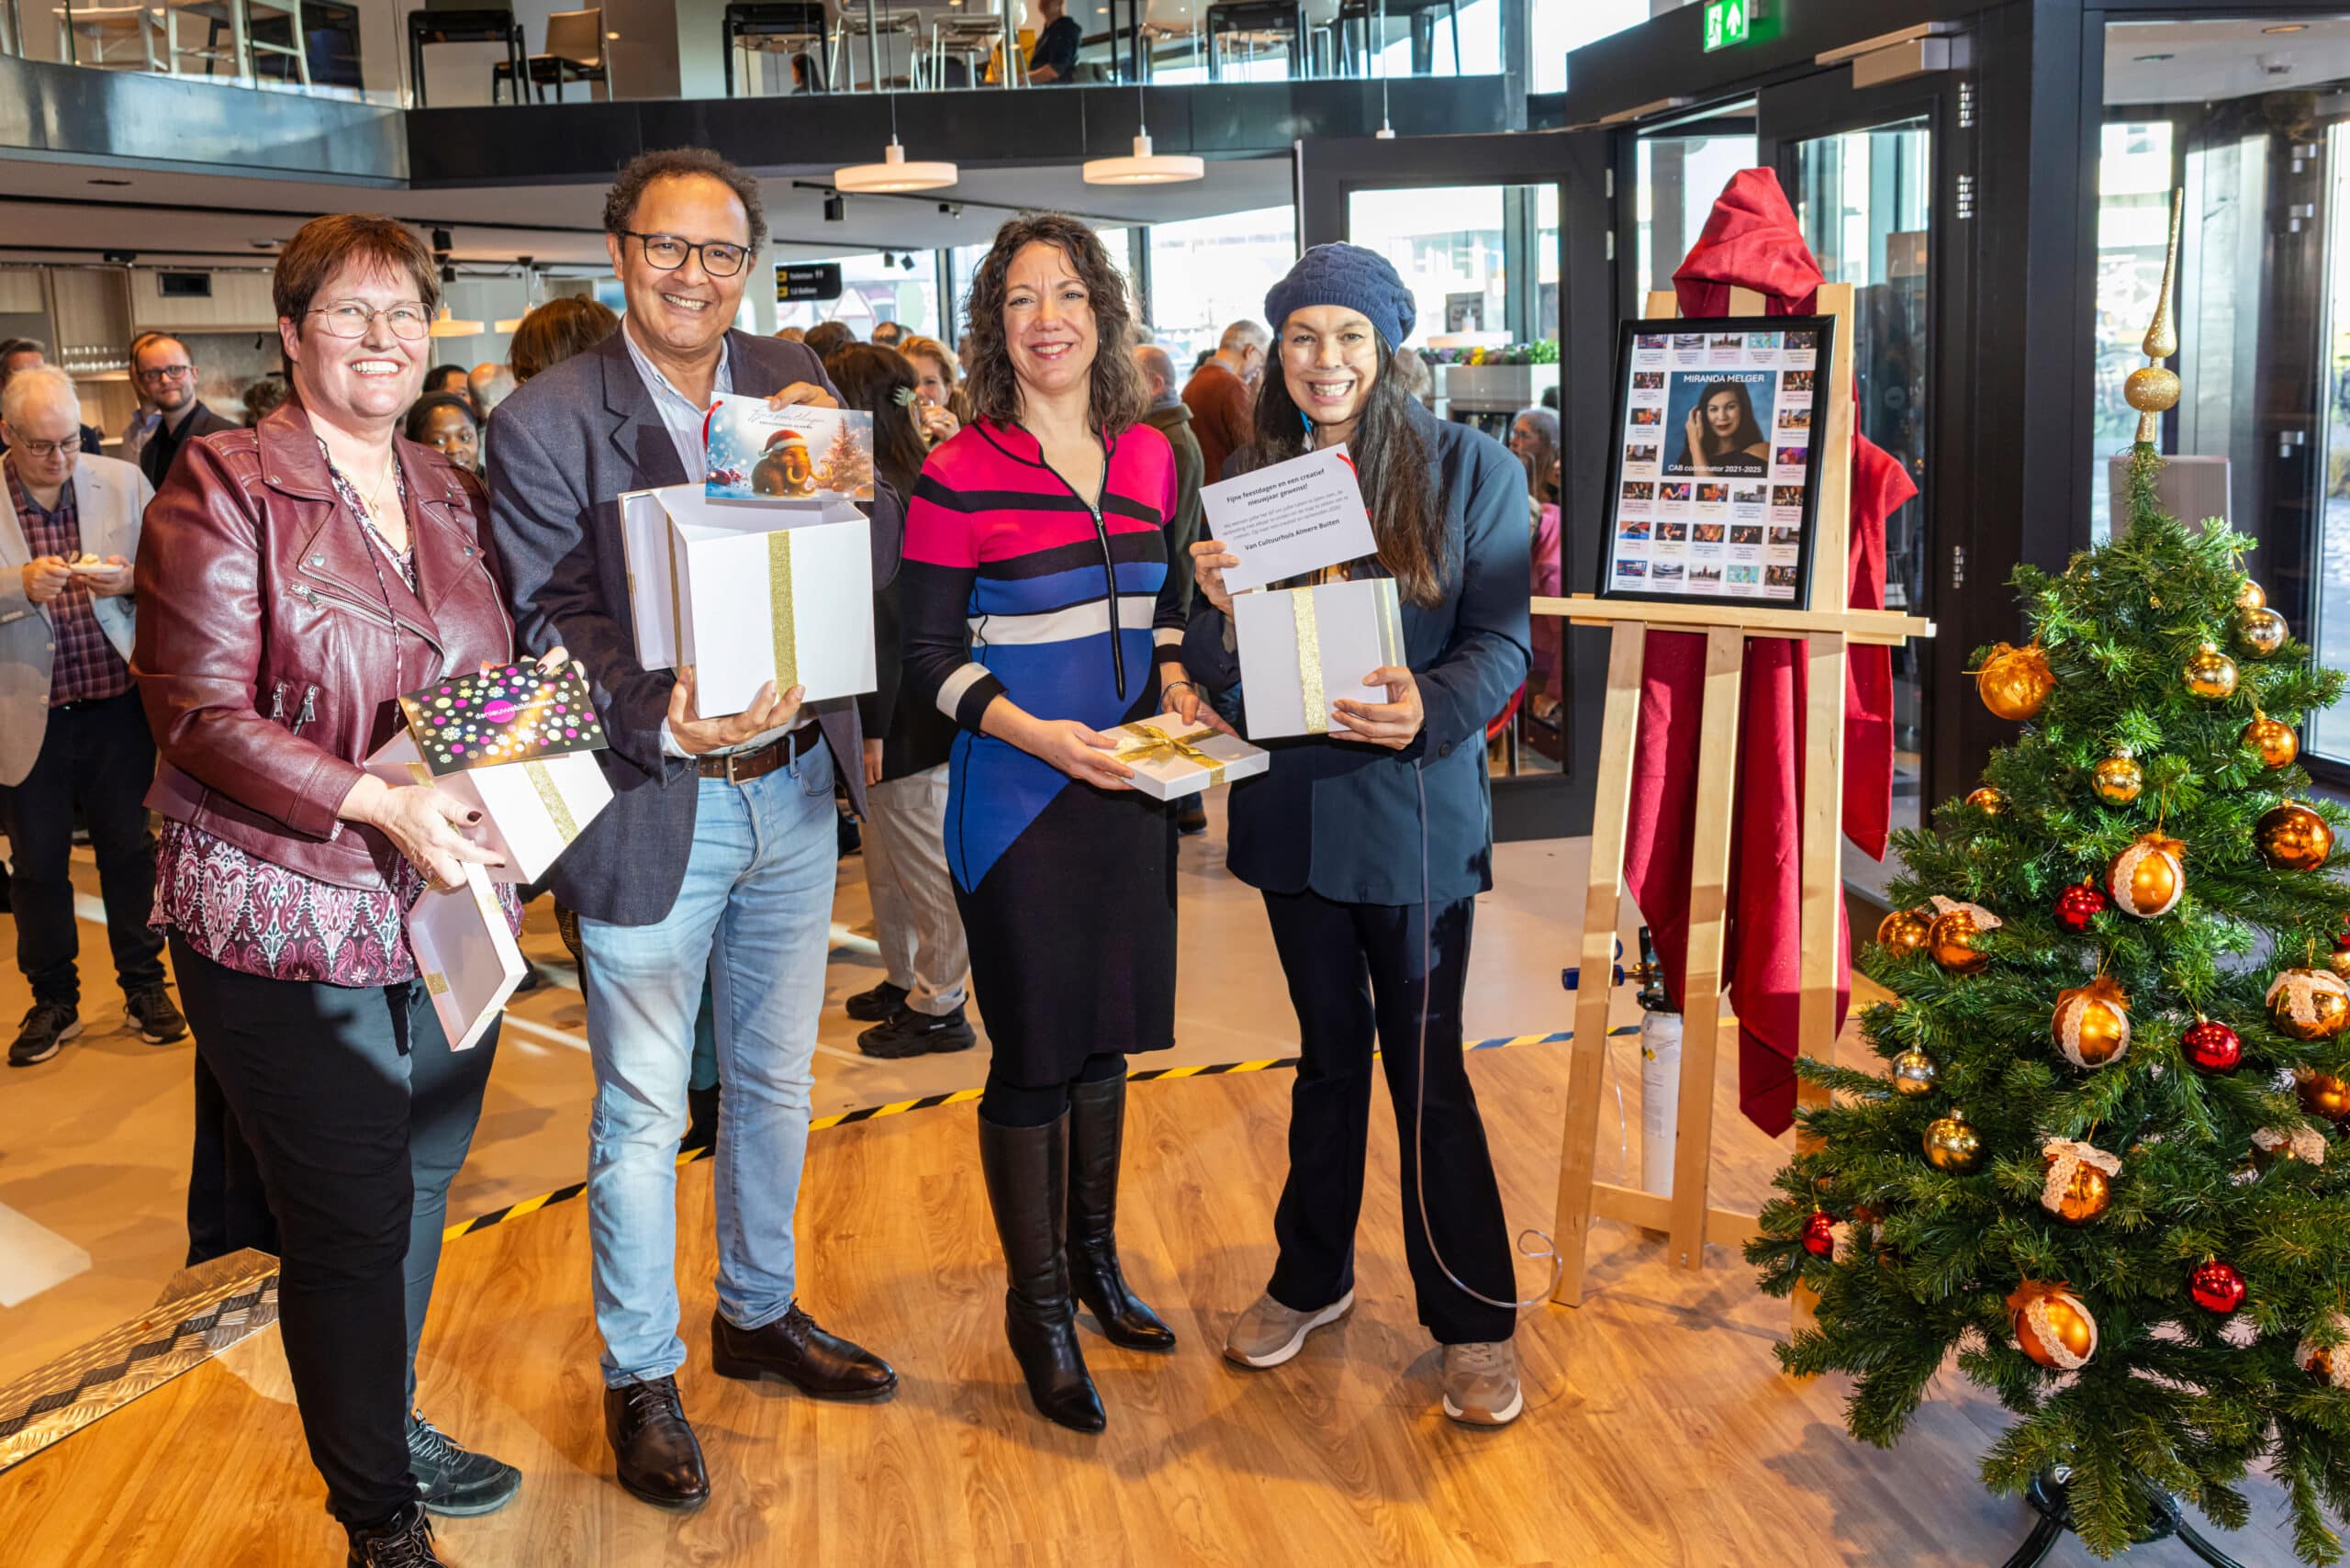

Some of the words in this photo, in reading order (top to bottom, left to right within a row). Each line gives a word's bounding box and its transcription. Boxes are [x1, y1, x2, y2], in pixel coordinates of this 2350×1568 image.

[1684, 374, 1726, 383] MIRANDA
[1727, 373, 1764, 383] MELGER
[1668, 464, 1684, 472] CAB
[1226, 495, 1242, 504] Fijne
[1243, 484, 1278, 498] feestdagen
[1287, 476, 1300, 485] een
[1300, 467, 1325, 482] creatief
[1248, 493, 1279, 507] nieuwjaar
[1280, 483, 1308, 498] gewenst!
[1244, 543, 1257, 551] Van
[1258, 532, 1295, 547] Cultuurhuis
[1295, 525, 1318, 536] Almere
[1319, 519, 1340, 530] Buiten
[476, 699, 555, 719] denieuwebibliek
